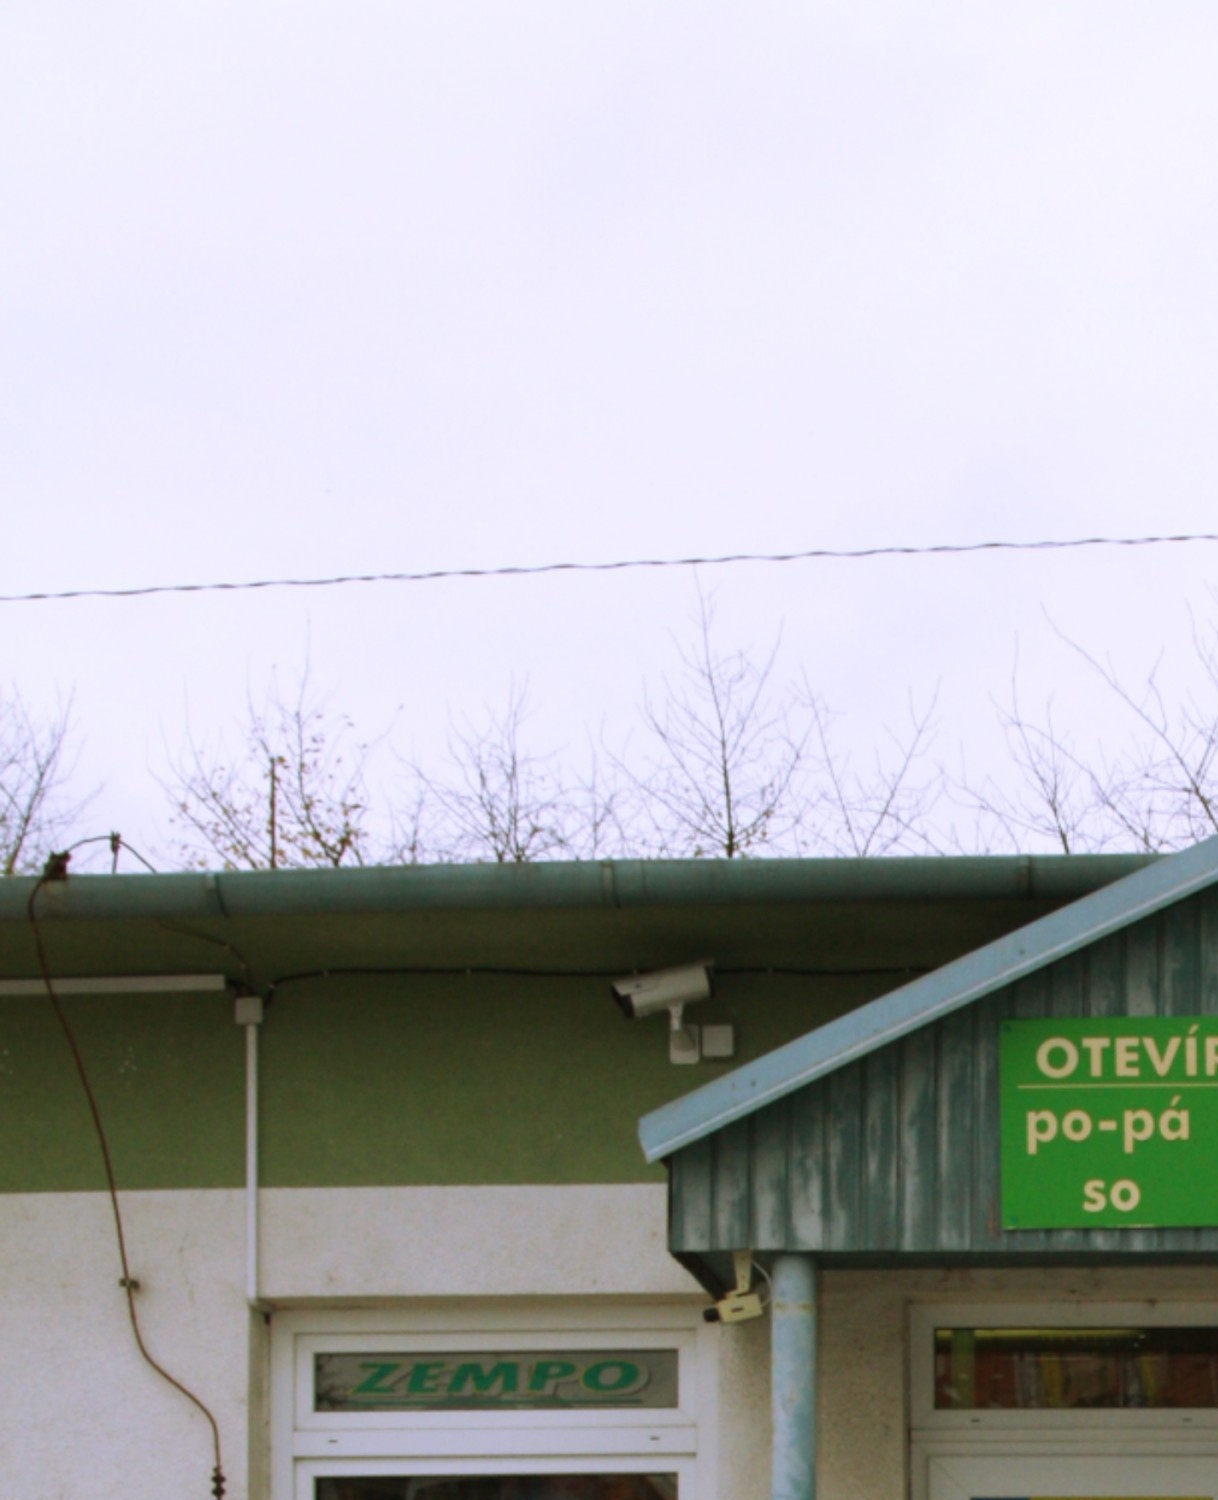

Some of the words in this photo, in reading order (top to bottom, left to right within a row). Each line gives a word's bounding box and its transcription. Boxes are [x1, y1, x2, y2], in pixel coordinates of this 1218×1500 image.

[1026, 1096, 1190, 1154] po-pá
[1082, 1178, 1141, 1212] so
[348, 1359, 648, 1397] ZEMPO
